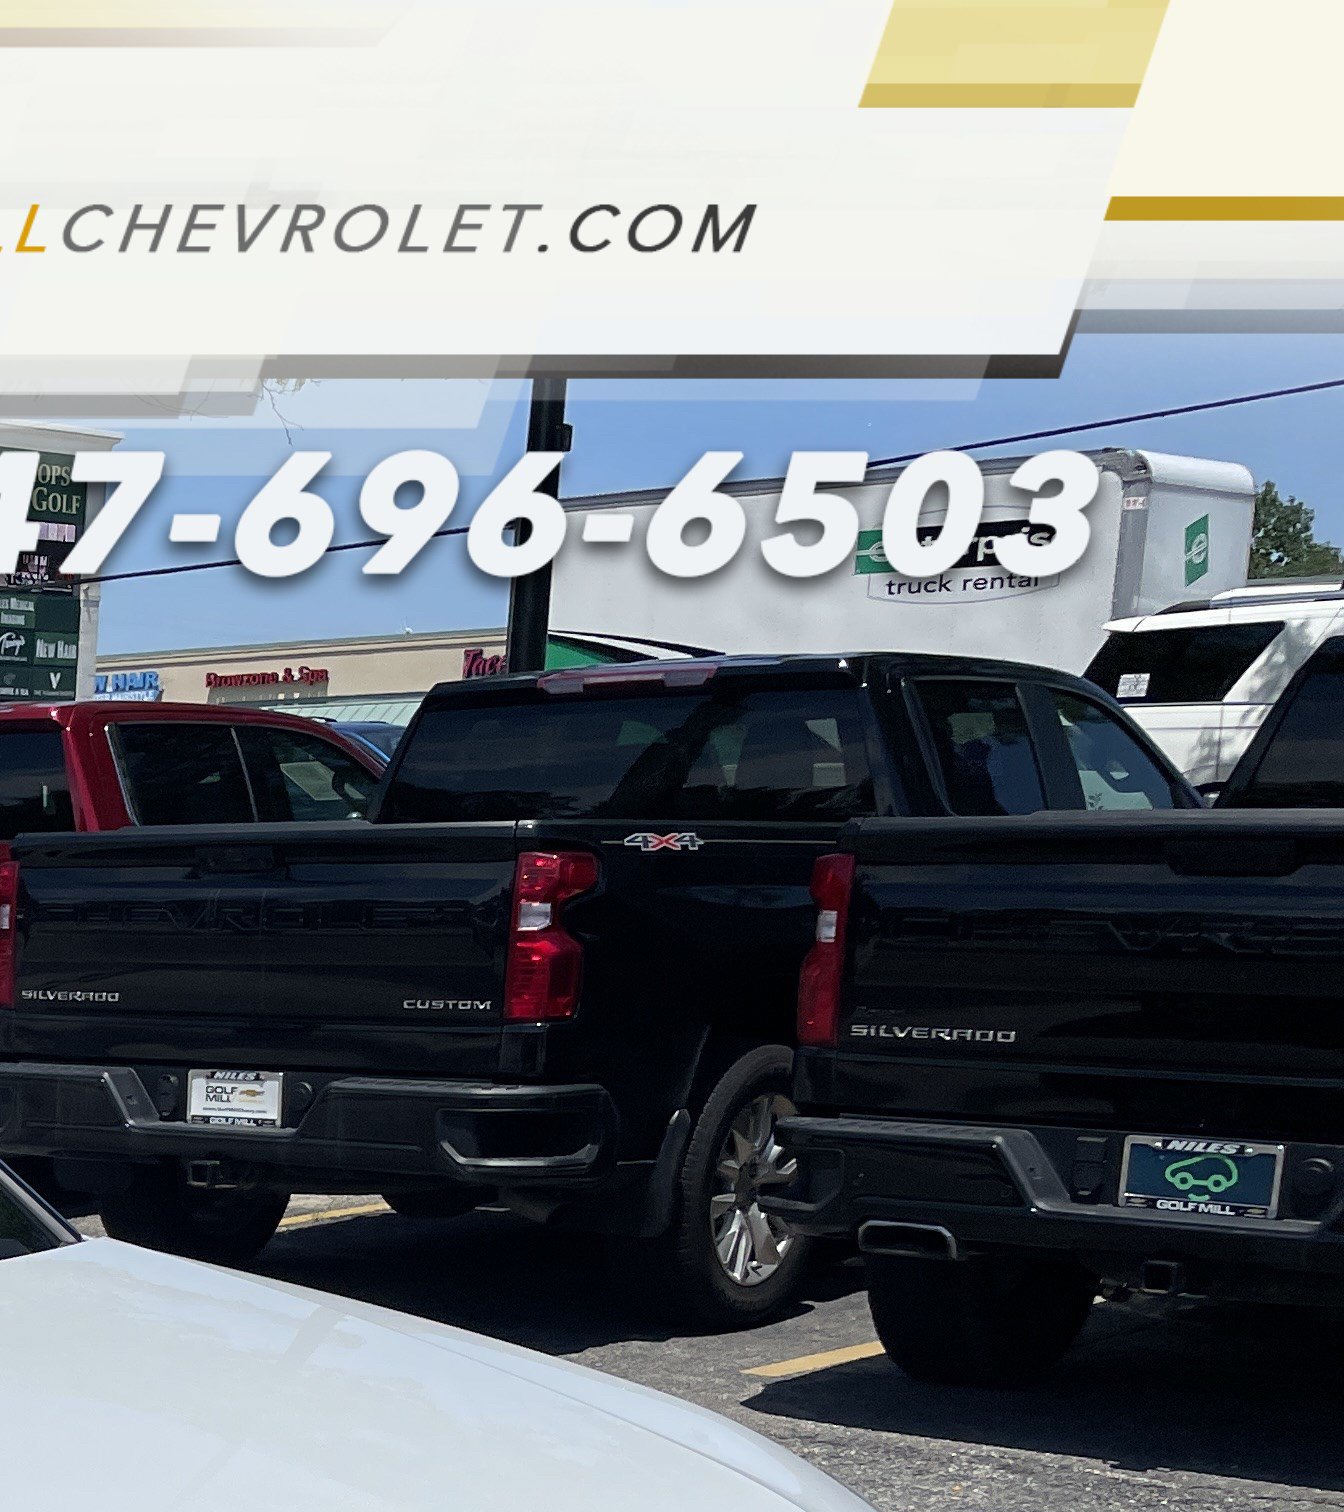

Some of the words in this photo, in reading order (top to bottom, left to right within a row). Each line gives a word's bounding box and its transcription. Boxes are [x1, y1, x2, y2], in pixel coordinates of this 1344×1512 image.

[885, 573, 953, 596] truck
[961, 575, 1040, 592] rental
[21, 989, 120, 1002] SILVERADO
[402, 999, 493, 1011] CUSTOM
[849, 1023, 1017, 1044] SILVERADO
[212, 1070, 258, 1081] NILES
[205, 1085, 239, 1095] GOLF
[1166, 1139, 1241, 1155] NILES
[1156, 1199, 1198, 1213] GOLF
[1198, 1203, 1237, 1216] MILL
